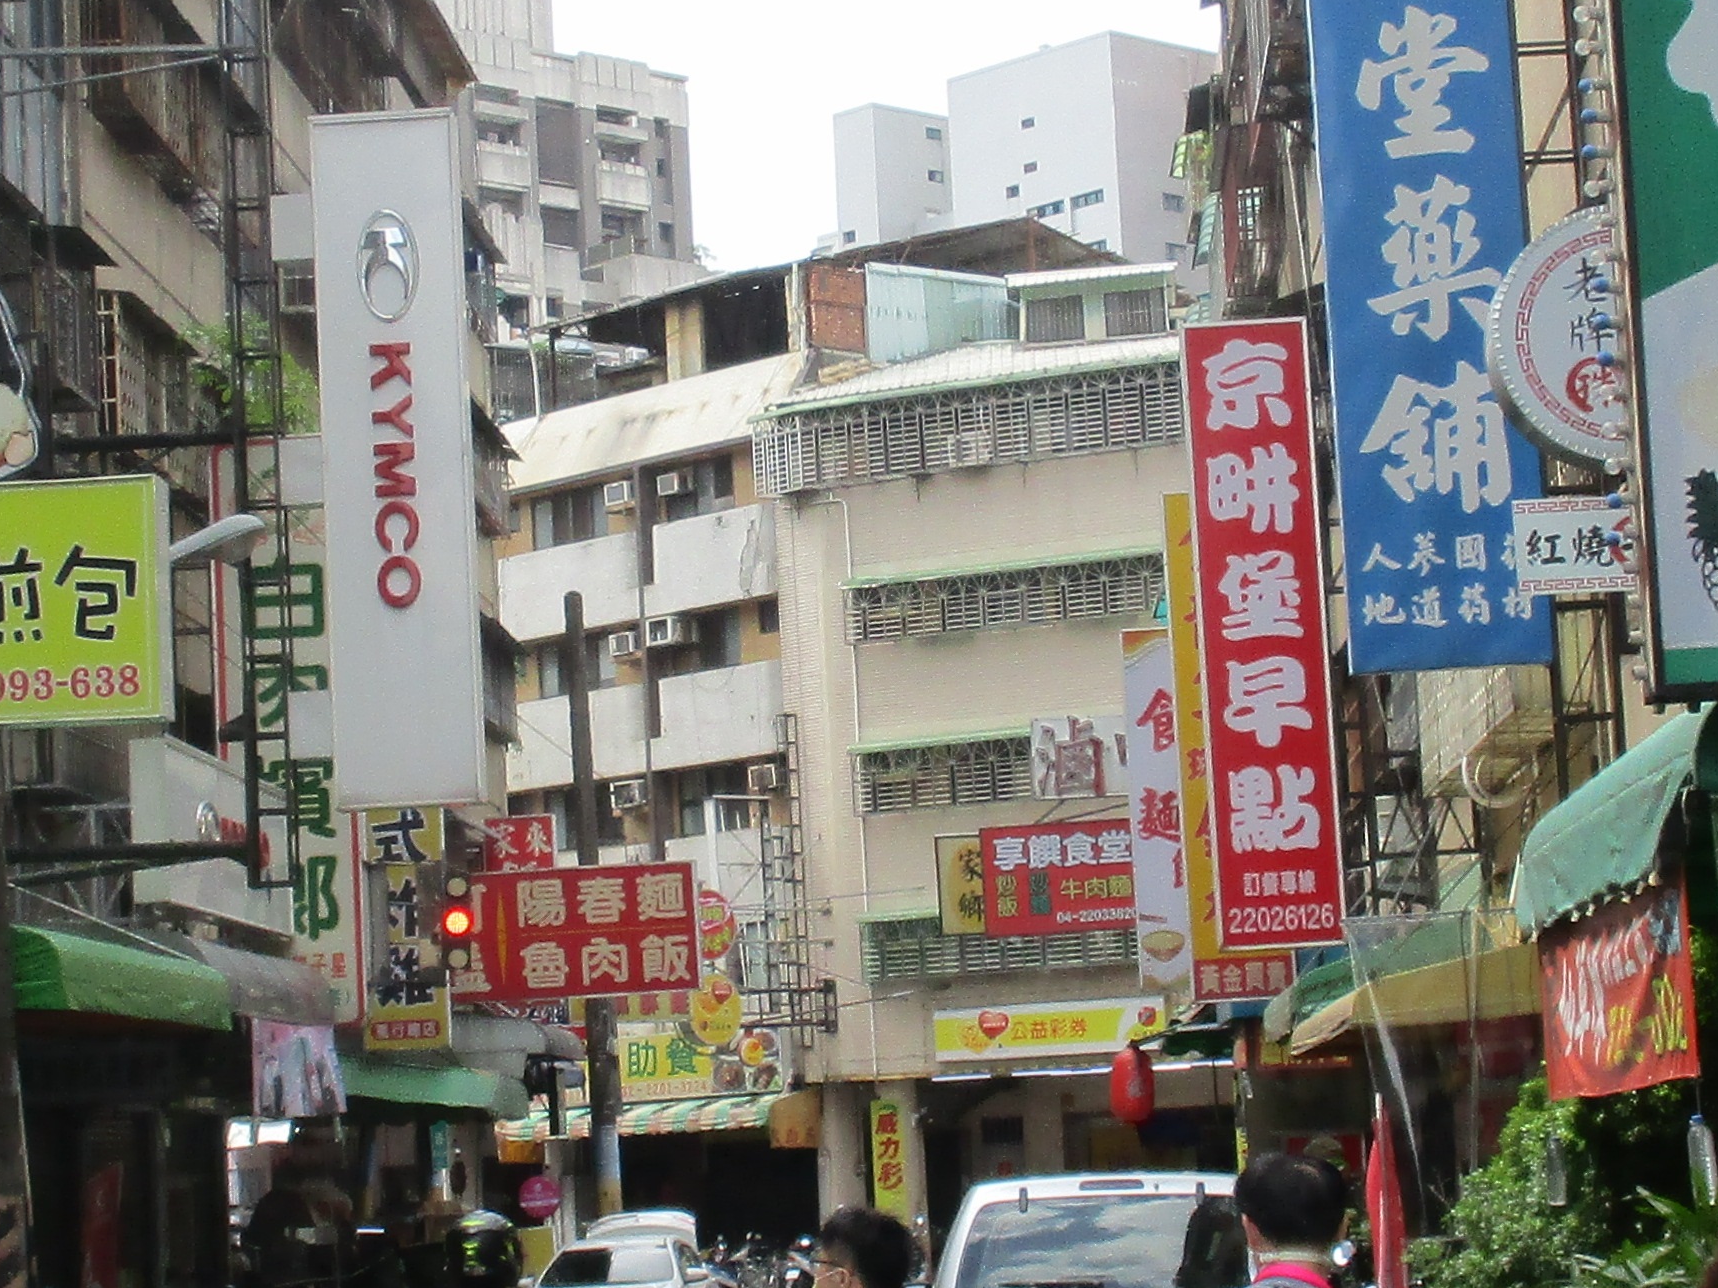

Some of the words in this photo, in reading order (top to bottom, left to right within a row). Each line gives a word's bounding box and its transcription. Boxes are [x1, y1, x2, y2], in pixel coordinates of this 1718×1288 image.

[368, 342, 422, 610] KYMCO
[516, 872, 687, 929] 陽春麵
[1227, 902, 1335, 935] 22026126
[519, 934, 692, 991] 魯肉飯
[1011, 1017, 1088, 1041] 公益彩券
[875, 1112, 904, 1191] 威力彩
